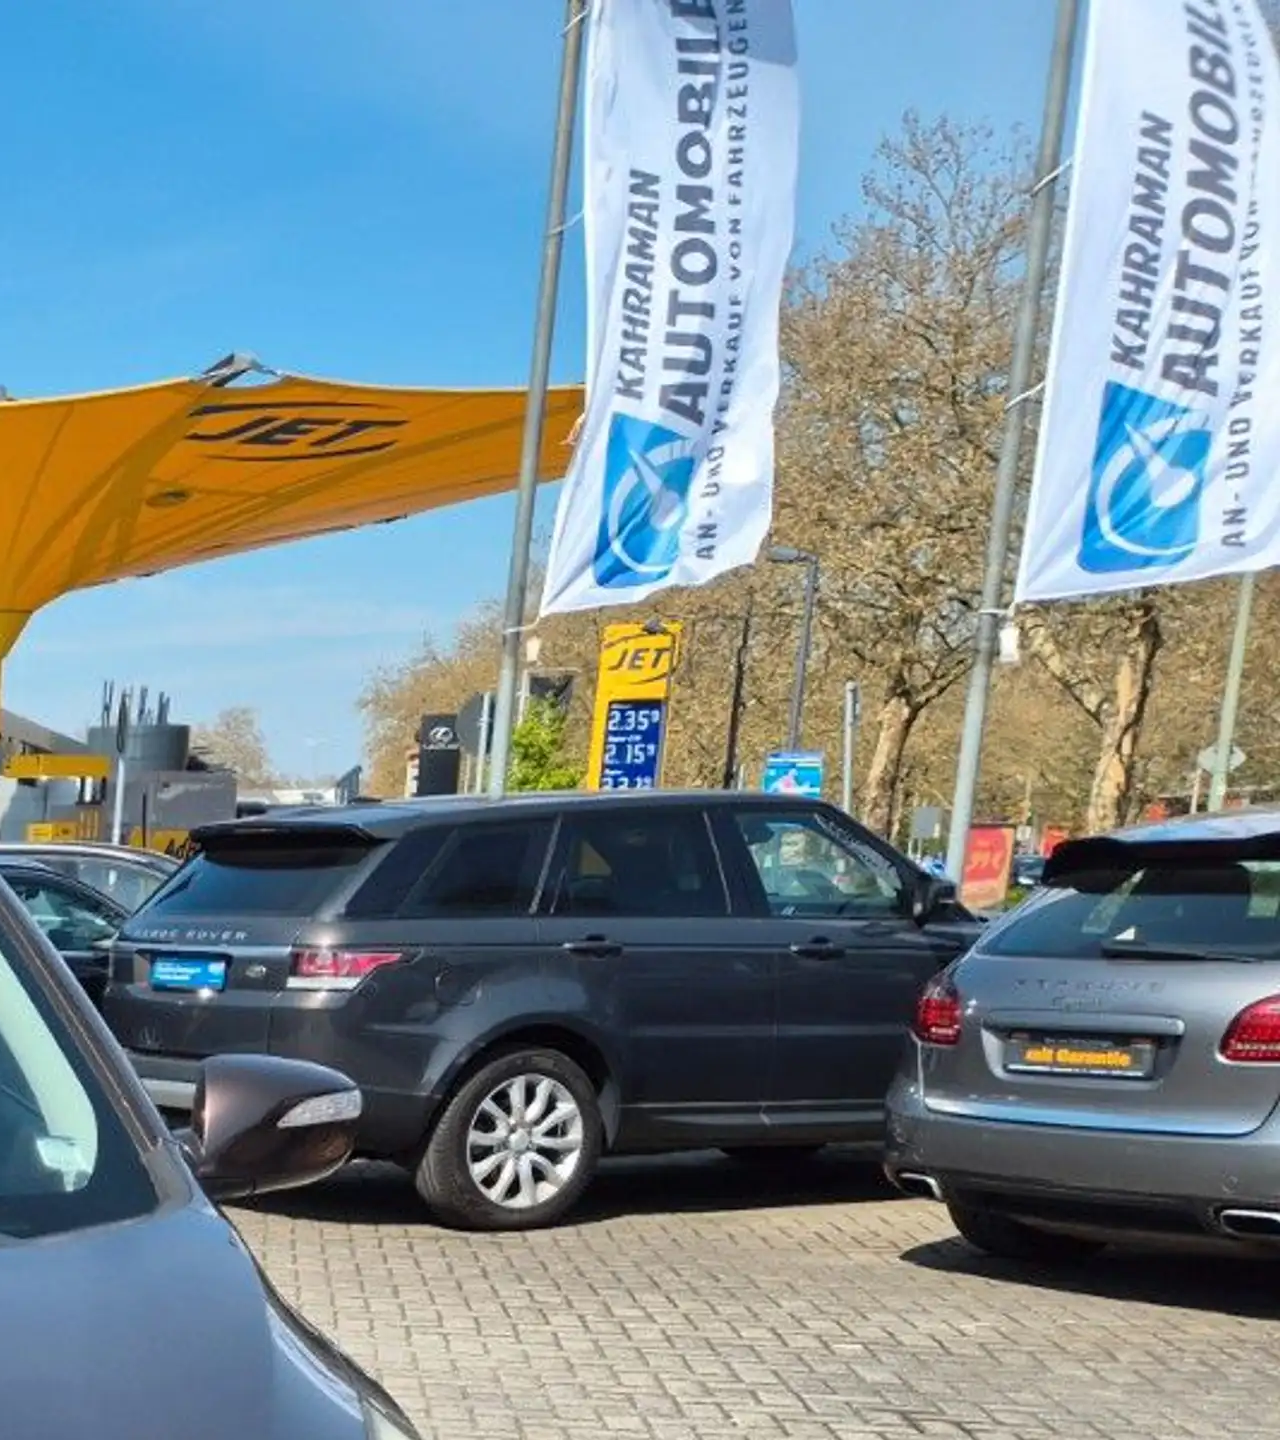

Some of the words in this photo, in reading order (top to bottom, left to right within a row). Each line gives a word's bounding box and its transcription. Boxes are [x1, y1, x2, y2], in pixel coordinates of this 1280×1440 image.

[728, 217, 743, 281] VON
[1109, 109, 1174, 371] KAHRAMAN
[1160, 0, 1239, 397] AUTOMOBIL
[615, 168, 661, 401] KAHRAMAN
[711, 294, 743, 436] VERKAUF
[1228, 268, 1263, 410] VERKAUF
[183, 415, 411, 447] JET
[699, 445, 725, 498] UND
[1224, 416, 1253, 482] UND
[608, 647, 671, 671] JET
